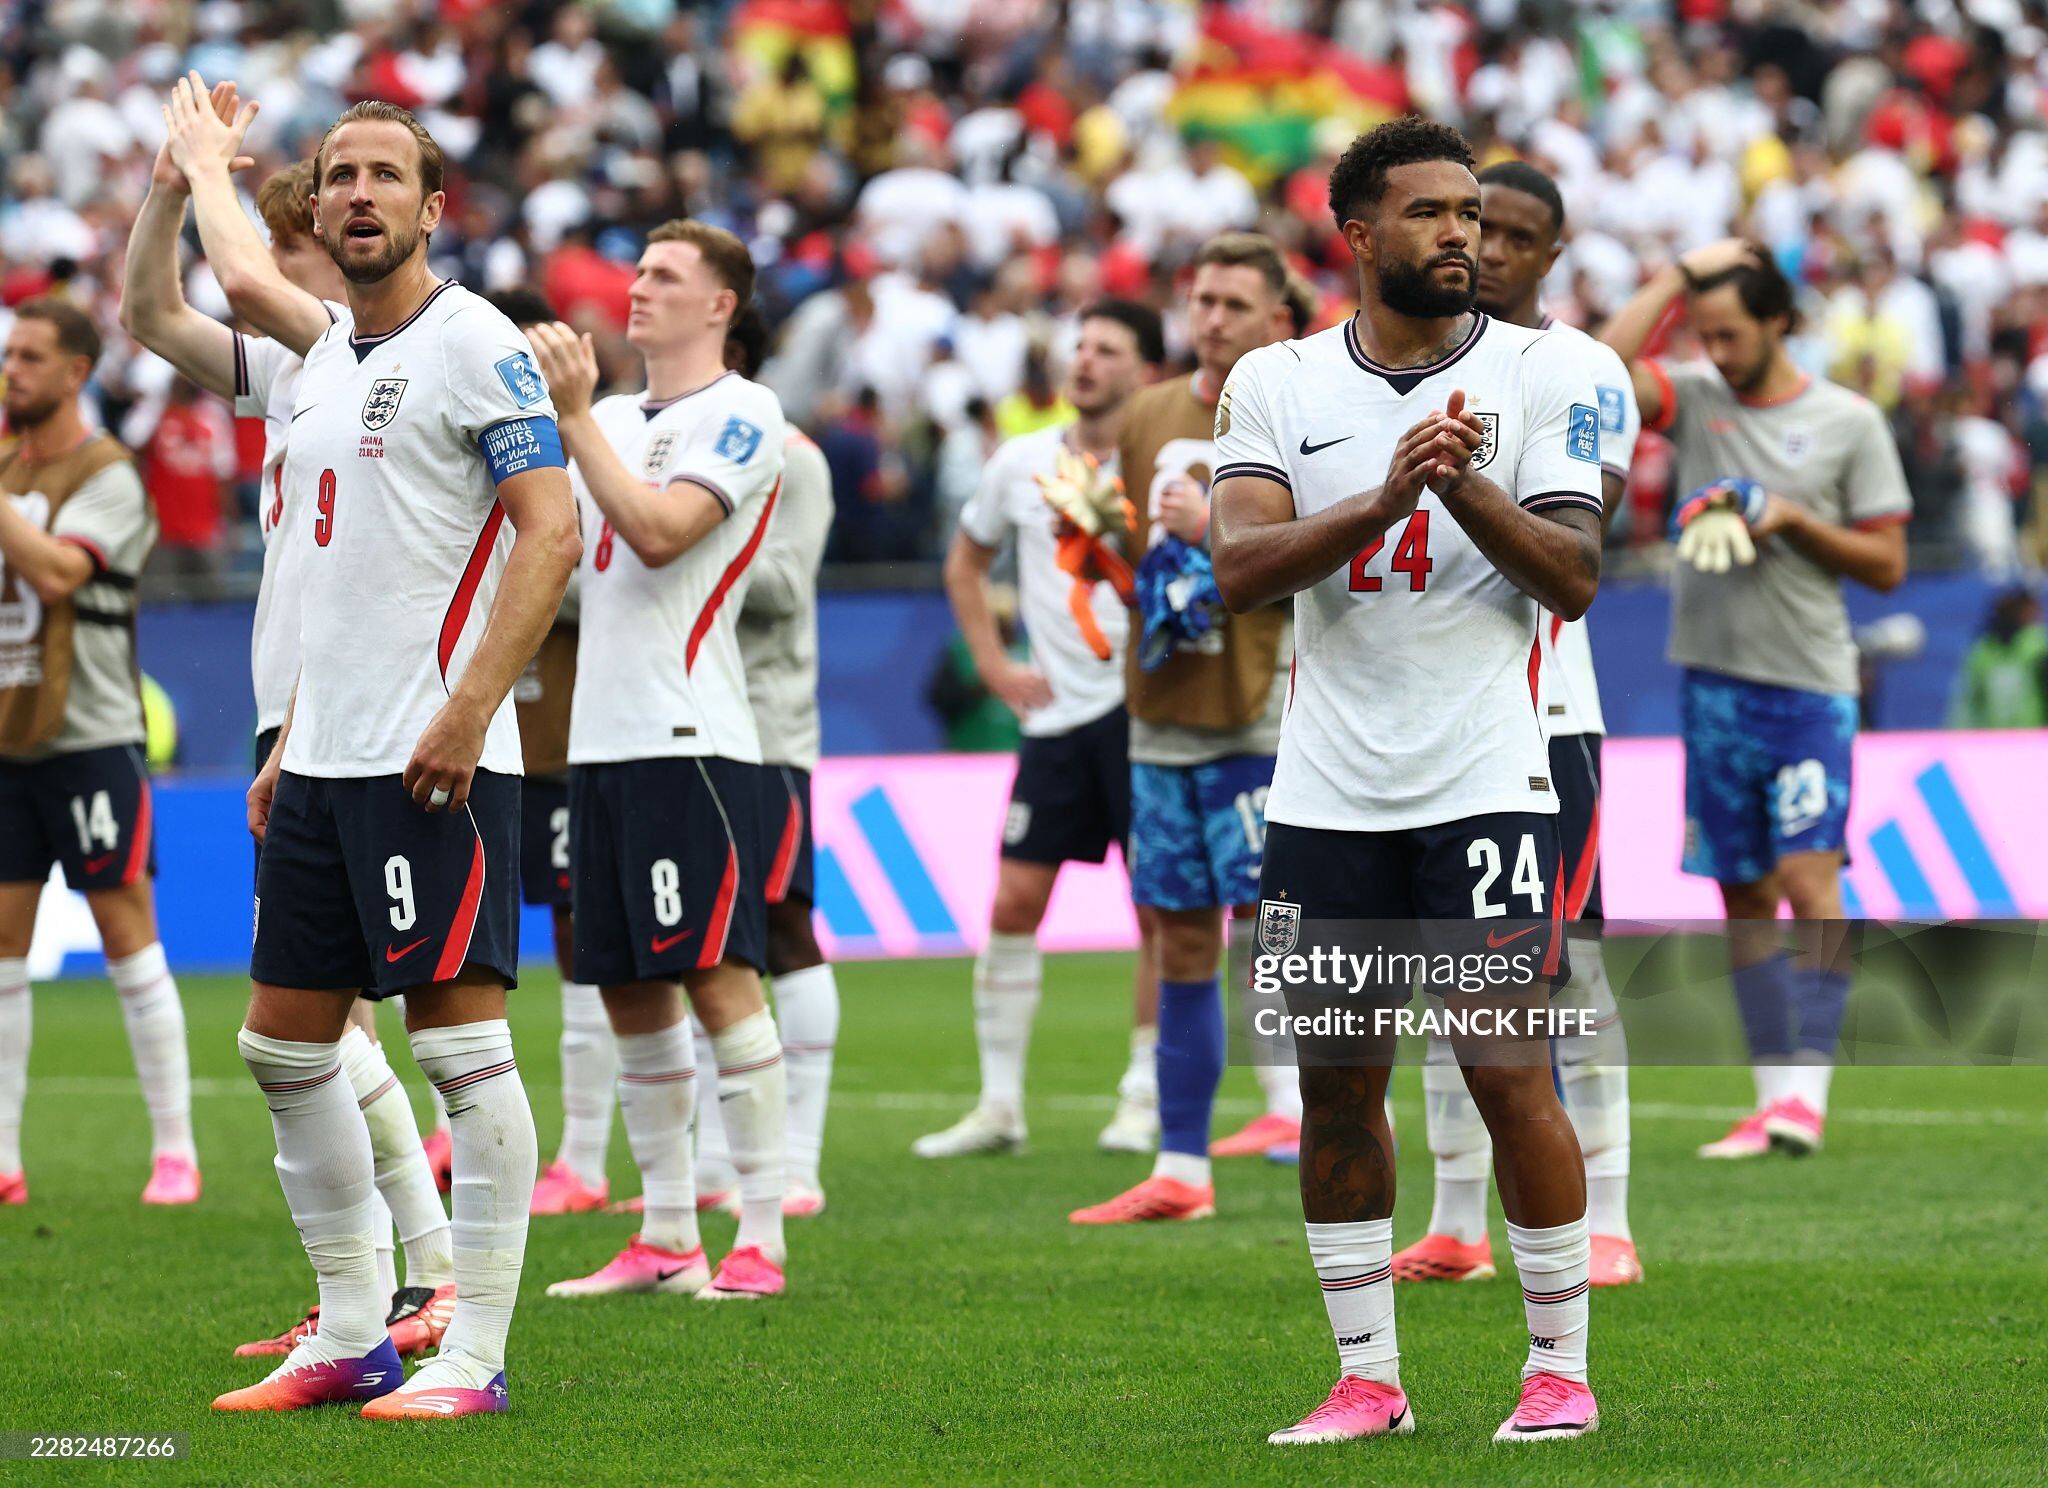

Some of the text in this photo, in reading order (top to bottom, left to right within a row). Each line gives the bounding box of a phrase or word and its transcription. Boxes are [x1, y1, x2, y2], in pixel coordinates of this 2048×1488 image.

[360, 435, 383, 446] GHANA
[485, 420, 532, 444] FOOTBALL
[488, 430, 535, 457] UNITES
[493, 442, 541, 470] the World
[507, 460, 527, 472] FIFA
[315, 468, 336, 547] 9
[1348, 509, 1432, 592] 24
[1777, 759, 1828, 821] 23
[71, 790, 118, 854] 14
[384, 854, 416, 931] 9
[651, 858, 682, 927] 8
[1466, 833, 1545, 919] 24
